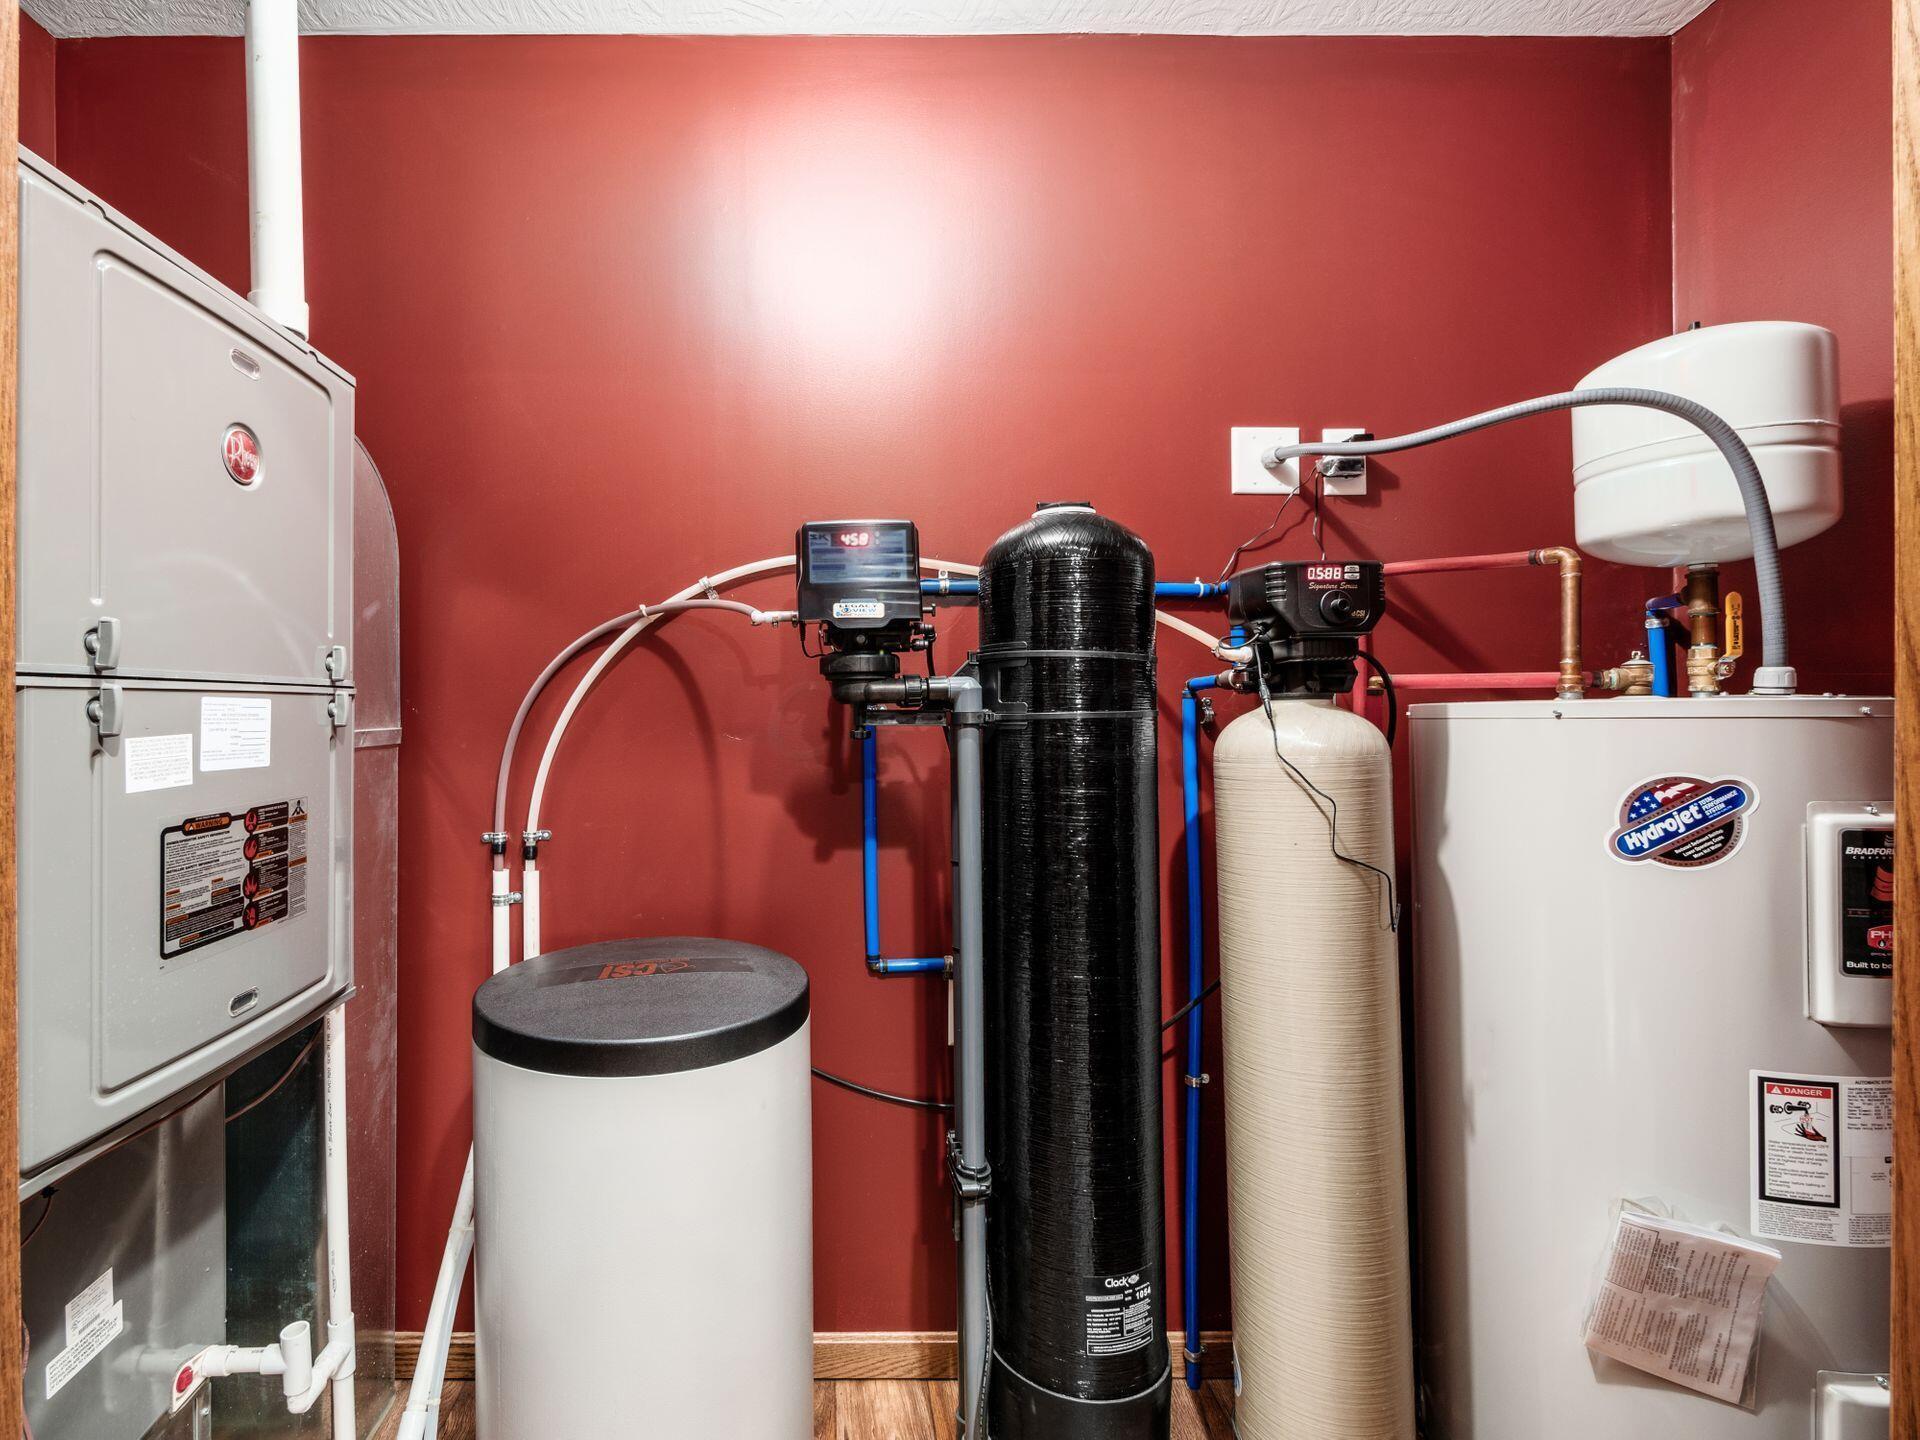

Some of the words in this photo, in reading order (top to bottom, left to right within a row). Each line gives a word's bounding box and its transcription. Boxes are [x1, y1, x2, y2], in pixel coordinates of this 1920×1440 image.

[1623, 804, 1702, 850] Hydrojet
[1845, 846, 1895, 855] BRADFOR
[1870, 930, 1894, 939] PH
[1846, 961, 1868, 969] Built
[1783, 1087, 1823, 1097] DANGER
[1104, 1276, 1129, 1288] Clack
[1136, 1286, 1151, 1299] 1054
